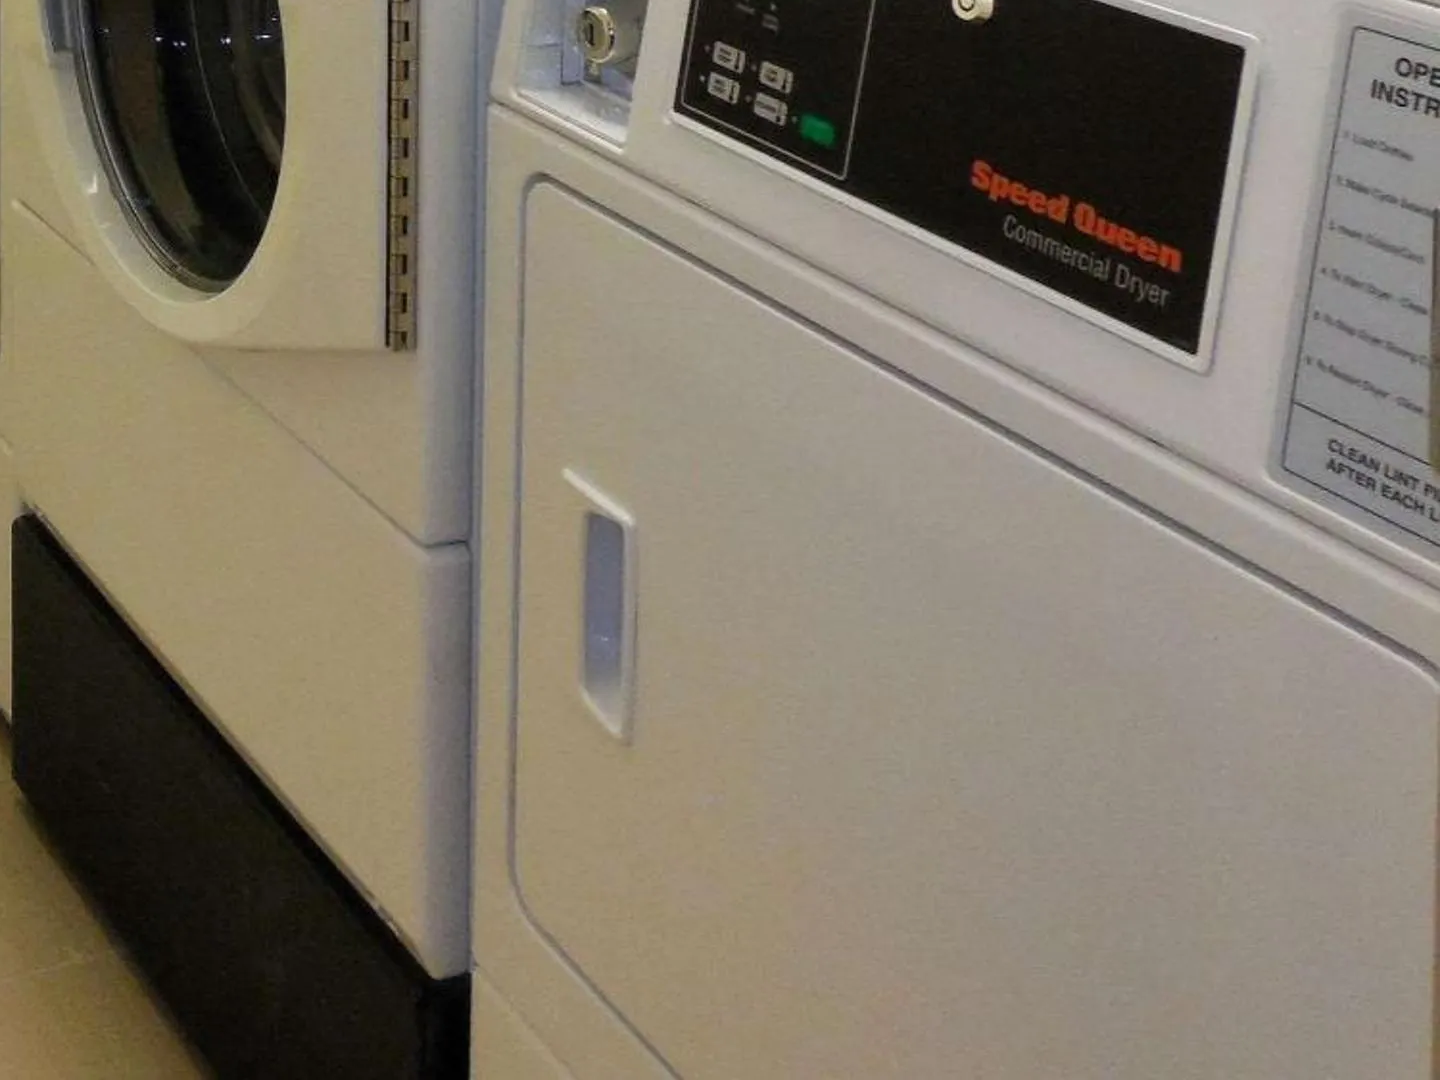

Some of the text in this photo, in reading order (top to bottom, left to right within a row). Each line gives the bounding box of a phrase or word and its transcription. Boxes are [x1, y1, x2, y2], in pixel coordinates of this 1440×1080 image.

[970, 159, 1182, 273] Speed Queen
[1002, 214, 1171, 307] Commercial Dryer
[1325, 457, 1377, 491] AFTER
[1381, 482, 1425, 515] EACH
[1327, 438, 1381, 471] CLEAN
[1383, 463, 1420, 491] LINT
